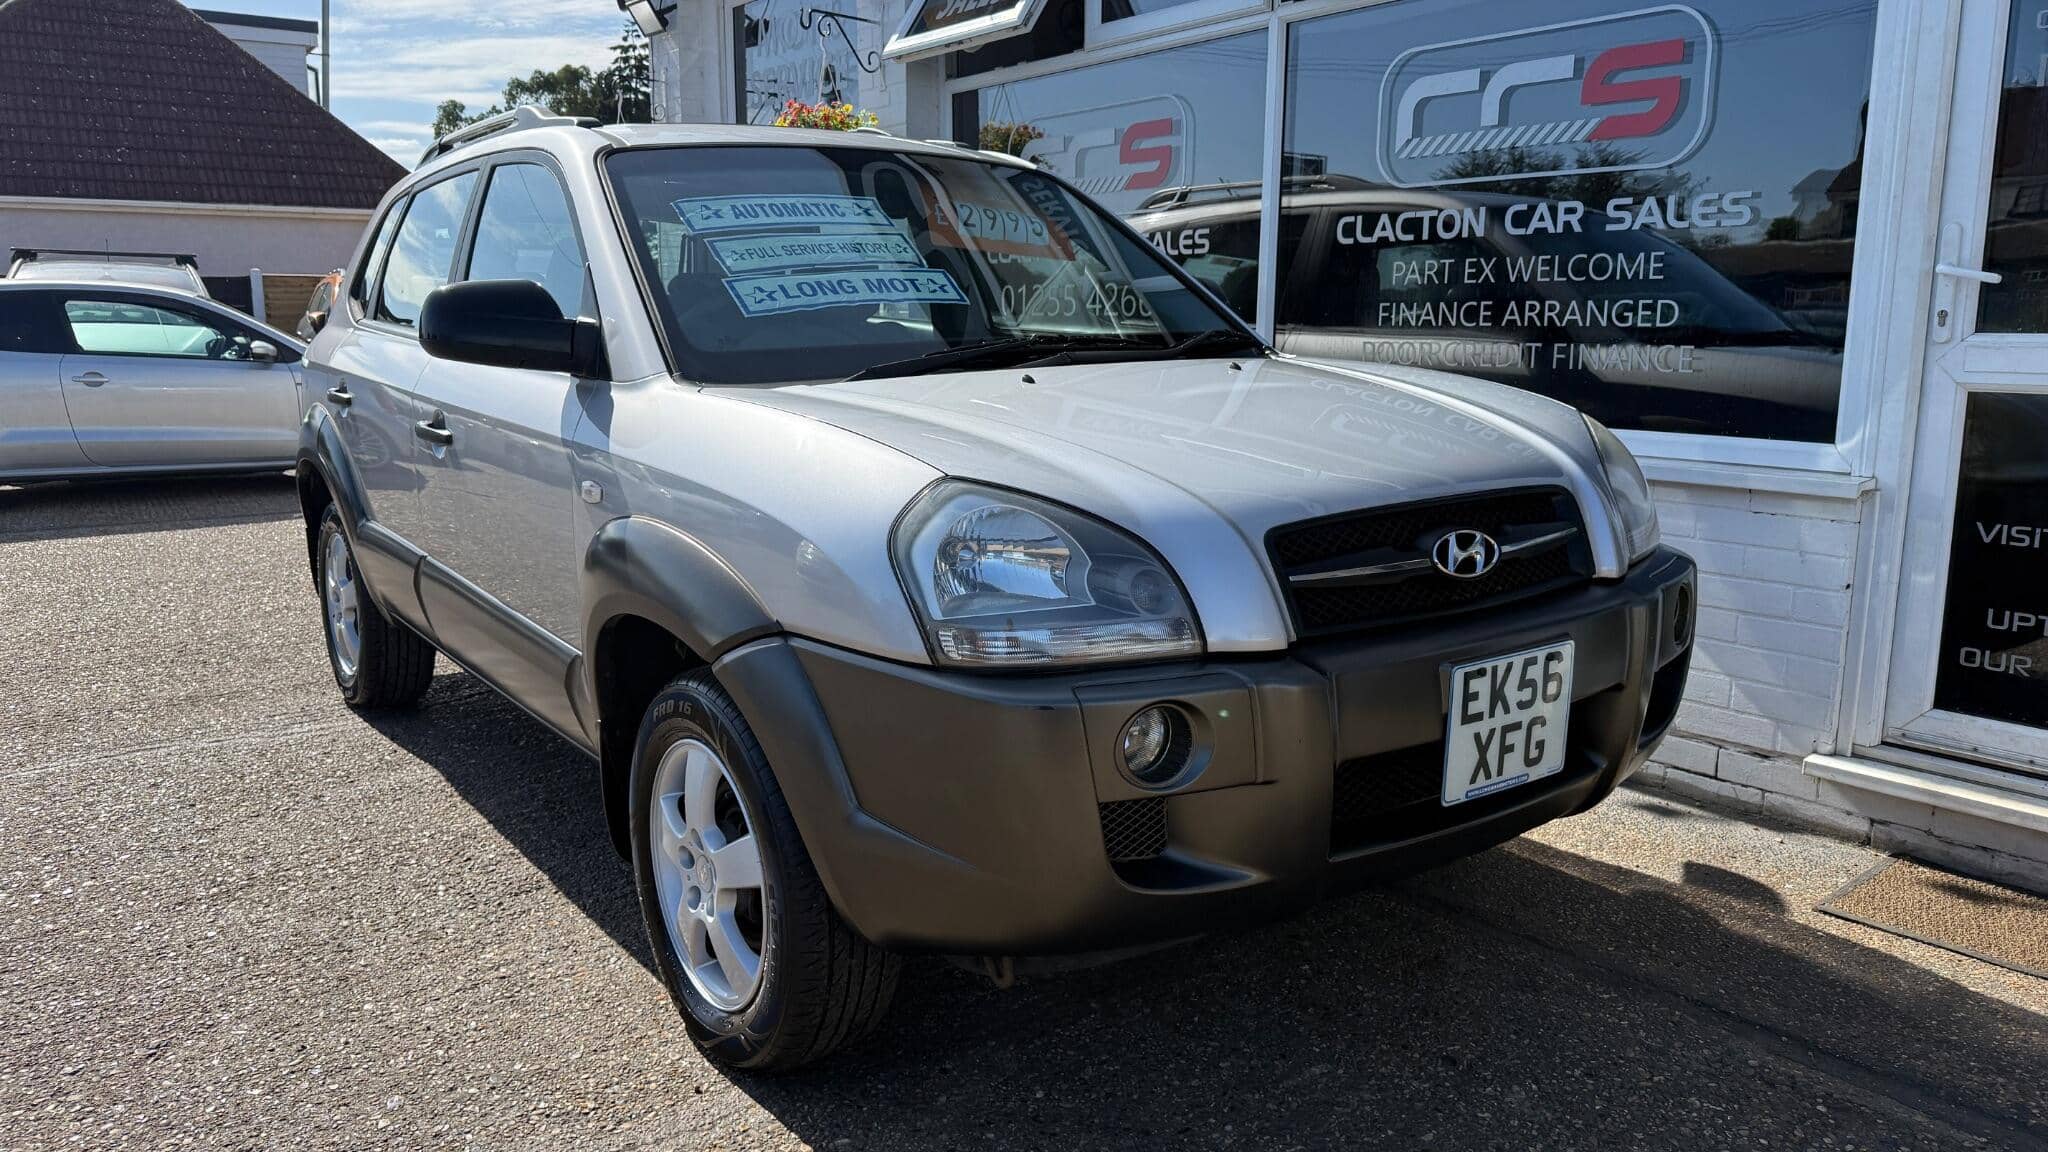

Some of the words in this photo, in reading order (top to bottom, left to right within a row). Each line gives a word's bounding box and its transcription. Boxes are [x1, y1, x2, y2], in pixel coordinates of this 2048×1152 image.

[731, 202, 846, 219] AUTOMATIC
[1336, 206, 1487, 246] CLACTON
[1504, 200, 1585, 236] CAR
[1605, 190, 1753, 231] SALES
[747, 246, 781, 260] FULL
[784, 243, 837, 257] SERVICE
[839, 241, 892, 256] HISTORY
[1392, 258, 1455, 286] PART
[1463, 256, 1497, 284] EX
[1506, 250, 1666, 283] WELCOME
[776, 281, 858, 299] LONG
[863, 278, 923, 295] MOT
[1000, 285, 1076, 317] 01255
[1377, 300, 1493, 327] FINANCE
[1501, 299, 1681, 328] ARRANGED
[1361, 340, 1433, 368] POOR
[1437, 340, 1543, 370] CREDIT
[1551, 342, 1697, 374] FINANCE
[1976, 522, 2048, 549] VISI
[1959, 647, 2032, 678] OUR
[1461, 650, 1564, 726] EK56
[1469, 715, 1547, 785] XFG
